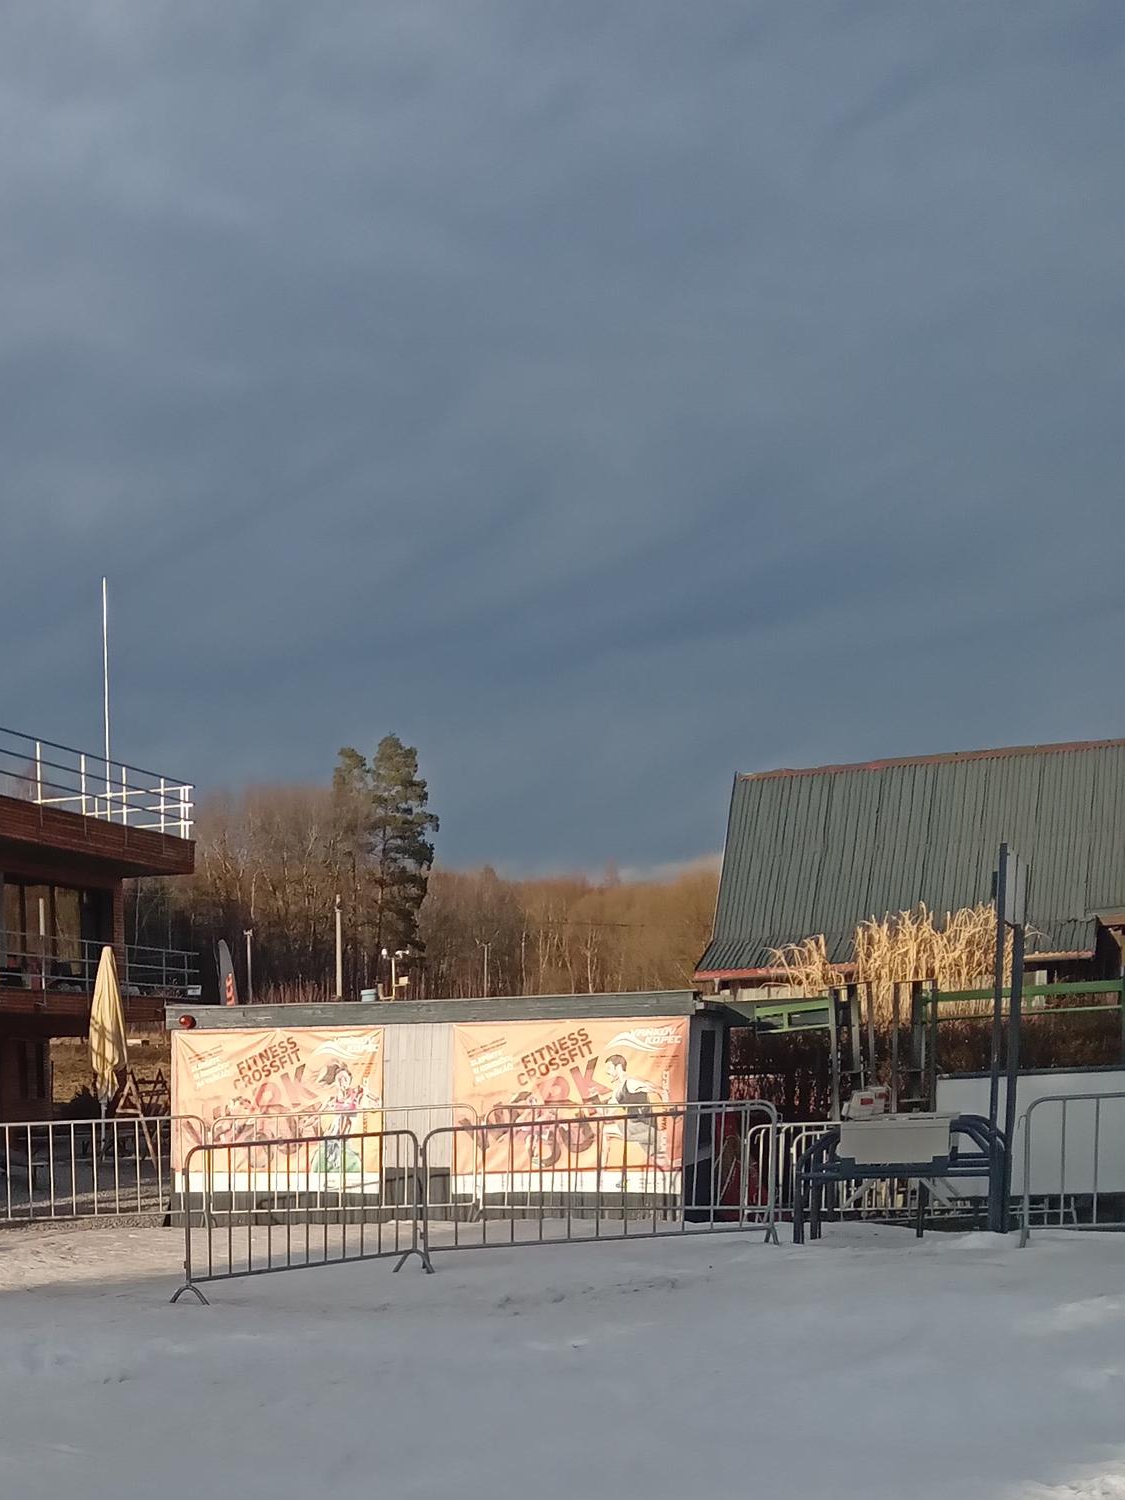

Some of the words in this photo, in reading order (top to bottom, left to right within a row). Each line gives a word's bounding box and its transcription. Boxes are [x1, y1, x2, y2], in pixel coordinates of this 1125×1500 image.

[236, 1036, 298, 1077] FITNESS
[516, 1041, 595, 1087] CROSSFIT
[521, 1027, 590, 1069] FITNESS
[233, 1048, 302, 1091] CROSSFIT
